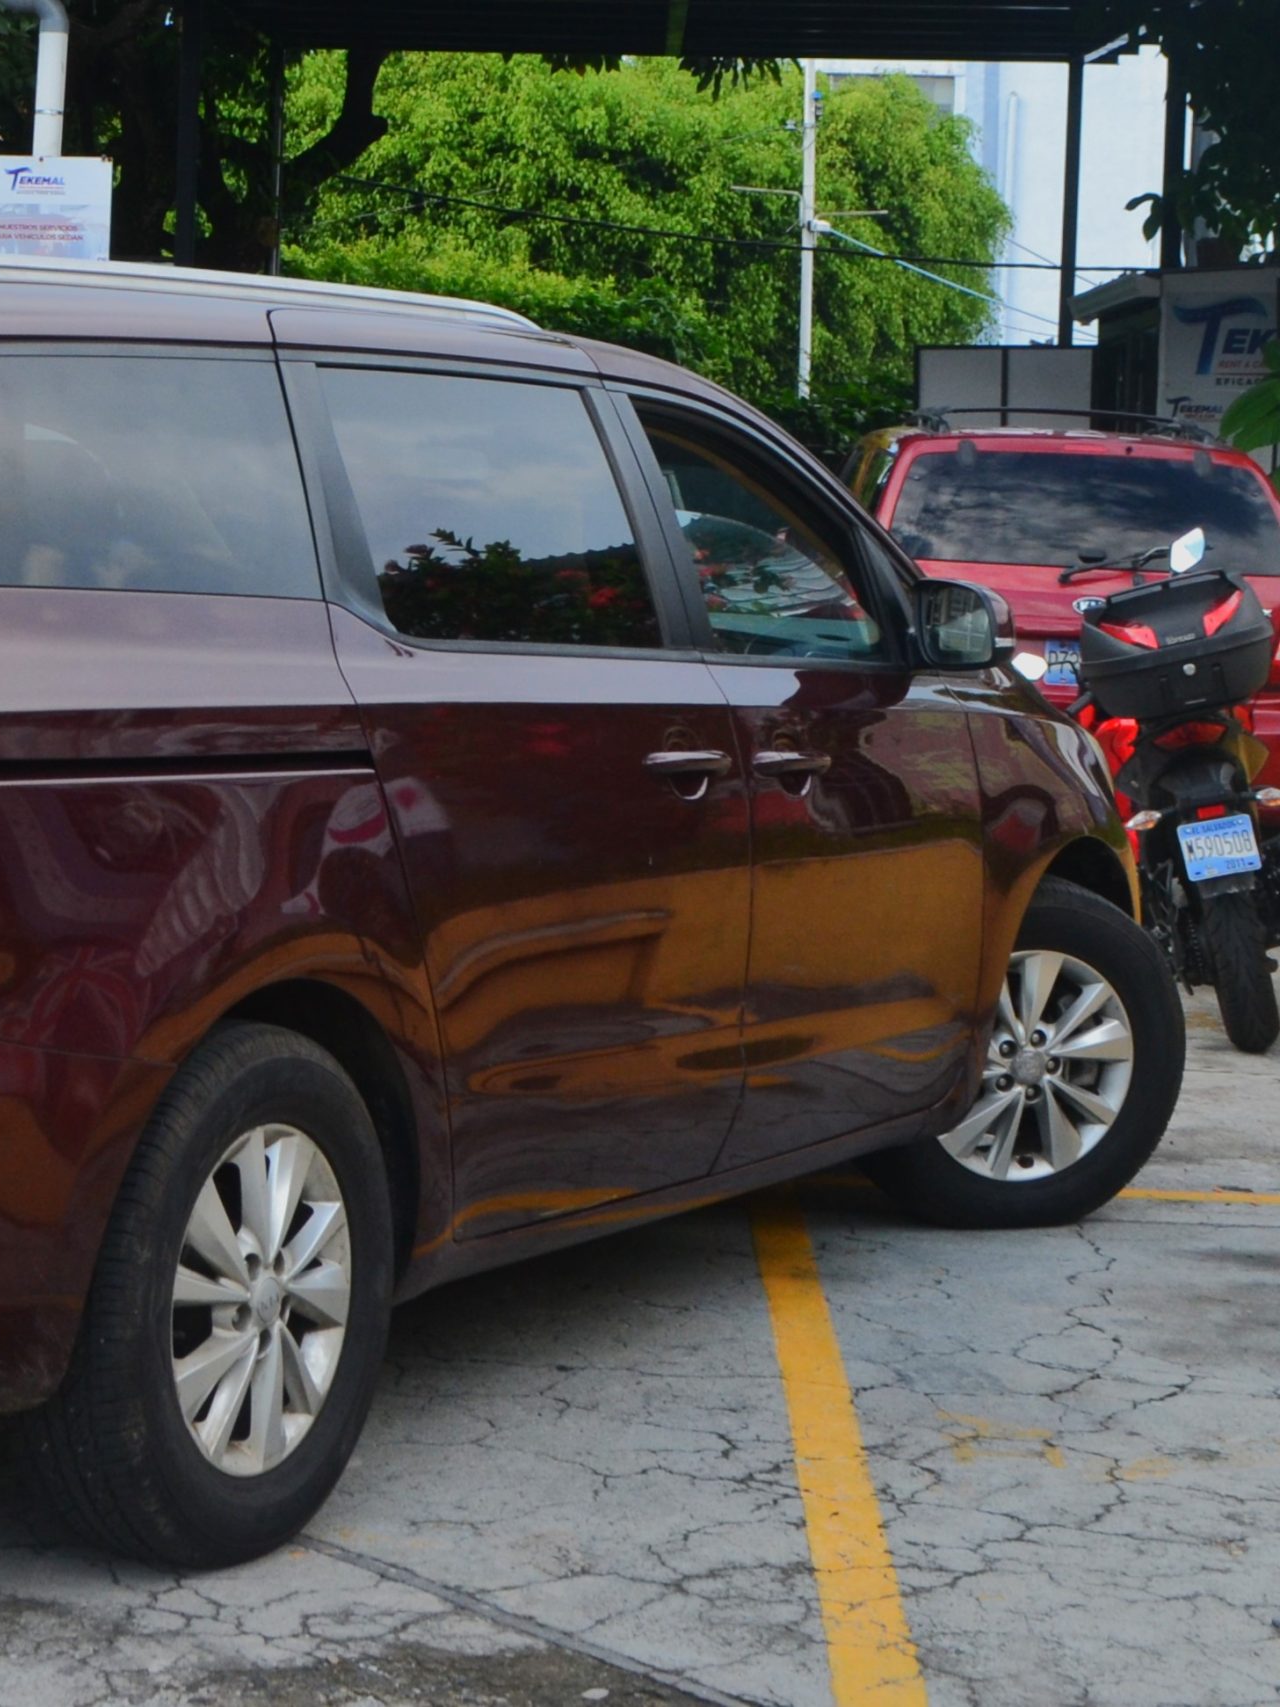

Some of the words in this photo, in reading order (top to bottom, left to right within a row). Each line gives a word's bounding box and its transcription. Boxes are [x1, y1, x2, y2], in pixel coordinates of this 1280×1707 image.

[4, 166, 66, 191] TEKEMAL
[1172, 296, 1277, 375] TEK
[1215, 377, 1262, 386] EFICAC
